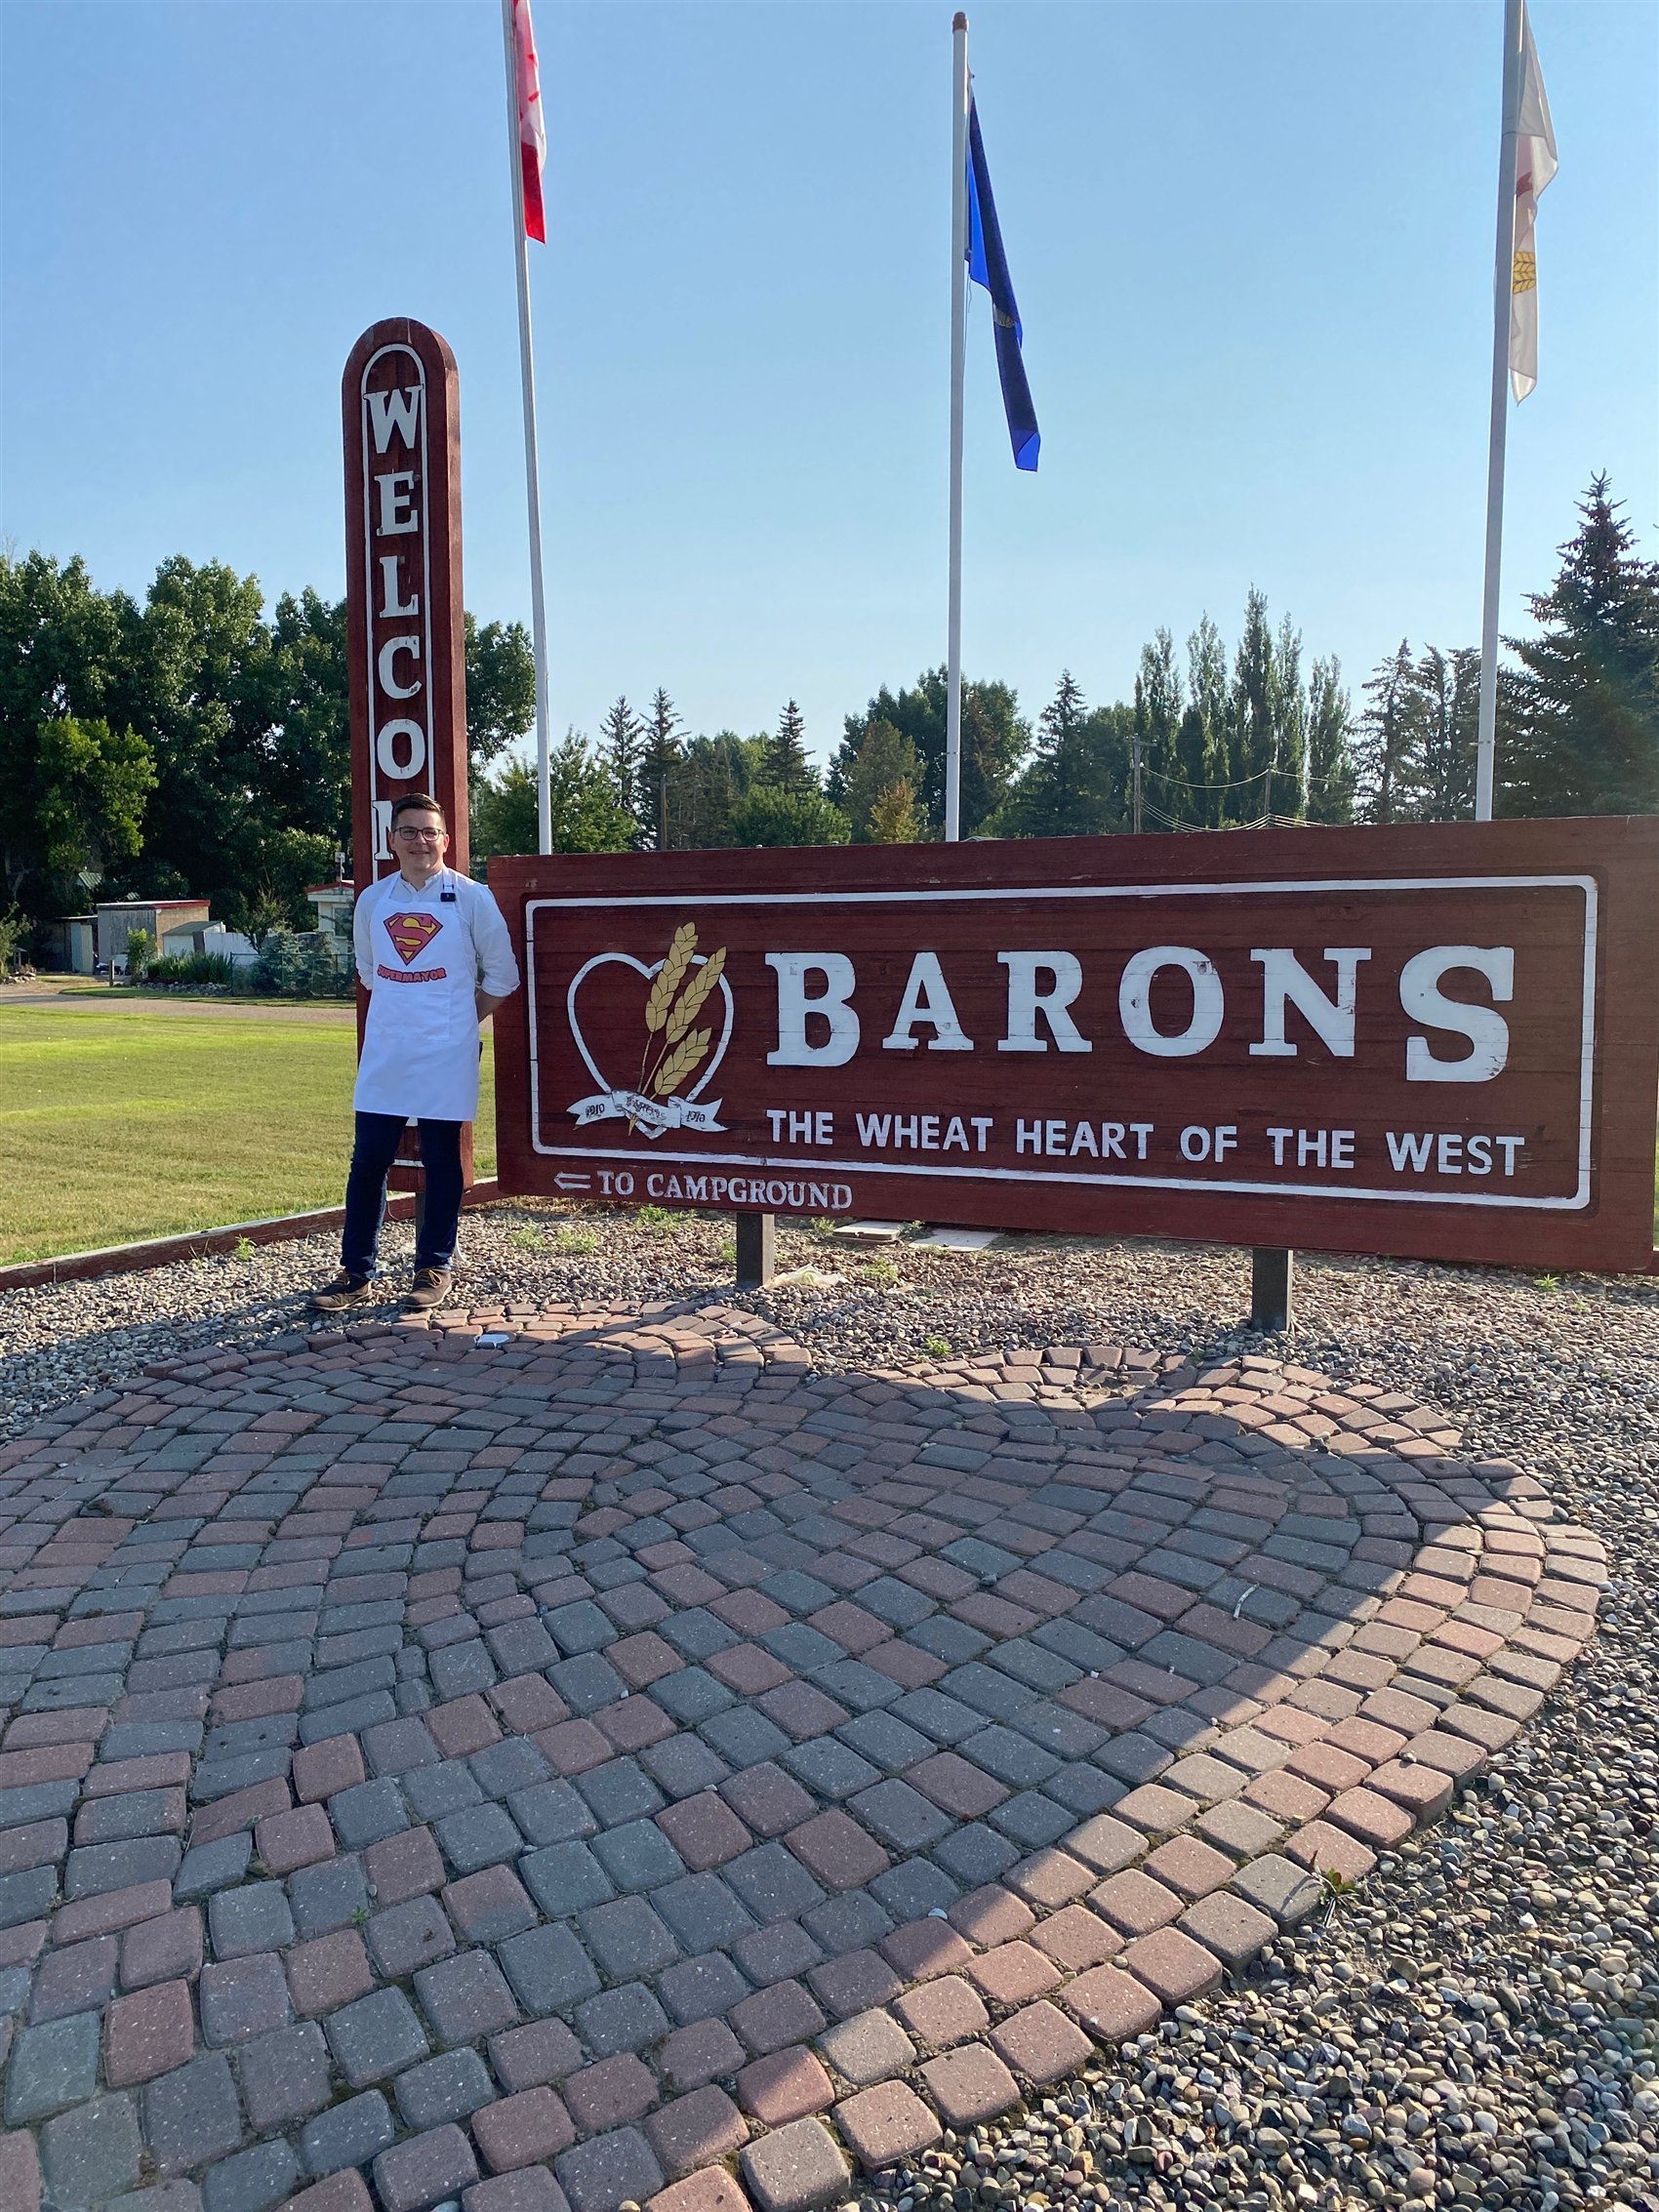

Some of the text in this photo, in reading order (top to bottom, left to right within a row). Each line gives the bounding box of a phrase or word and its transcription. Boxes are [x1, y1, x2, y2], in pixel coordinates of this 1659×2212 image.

[765, 945, 1515, 1083] BARONS
[766, 1108, 1525, 1176] THE WHEAT HEART OF THE WEST
[596, 1170, 854, 1211] TO CAMPGROUND
